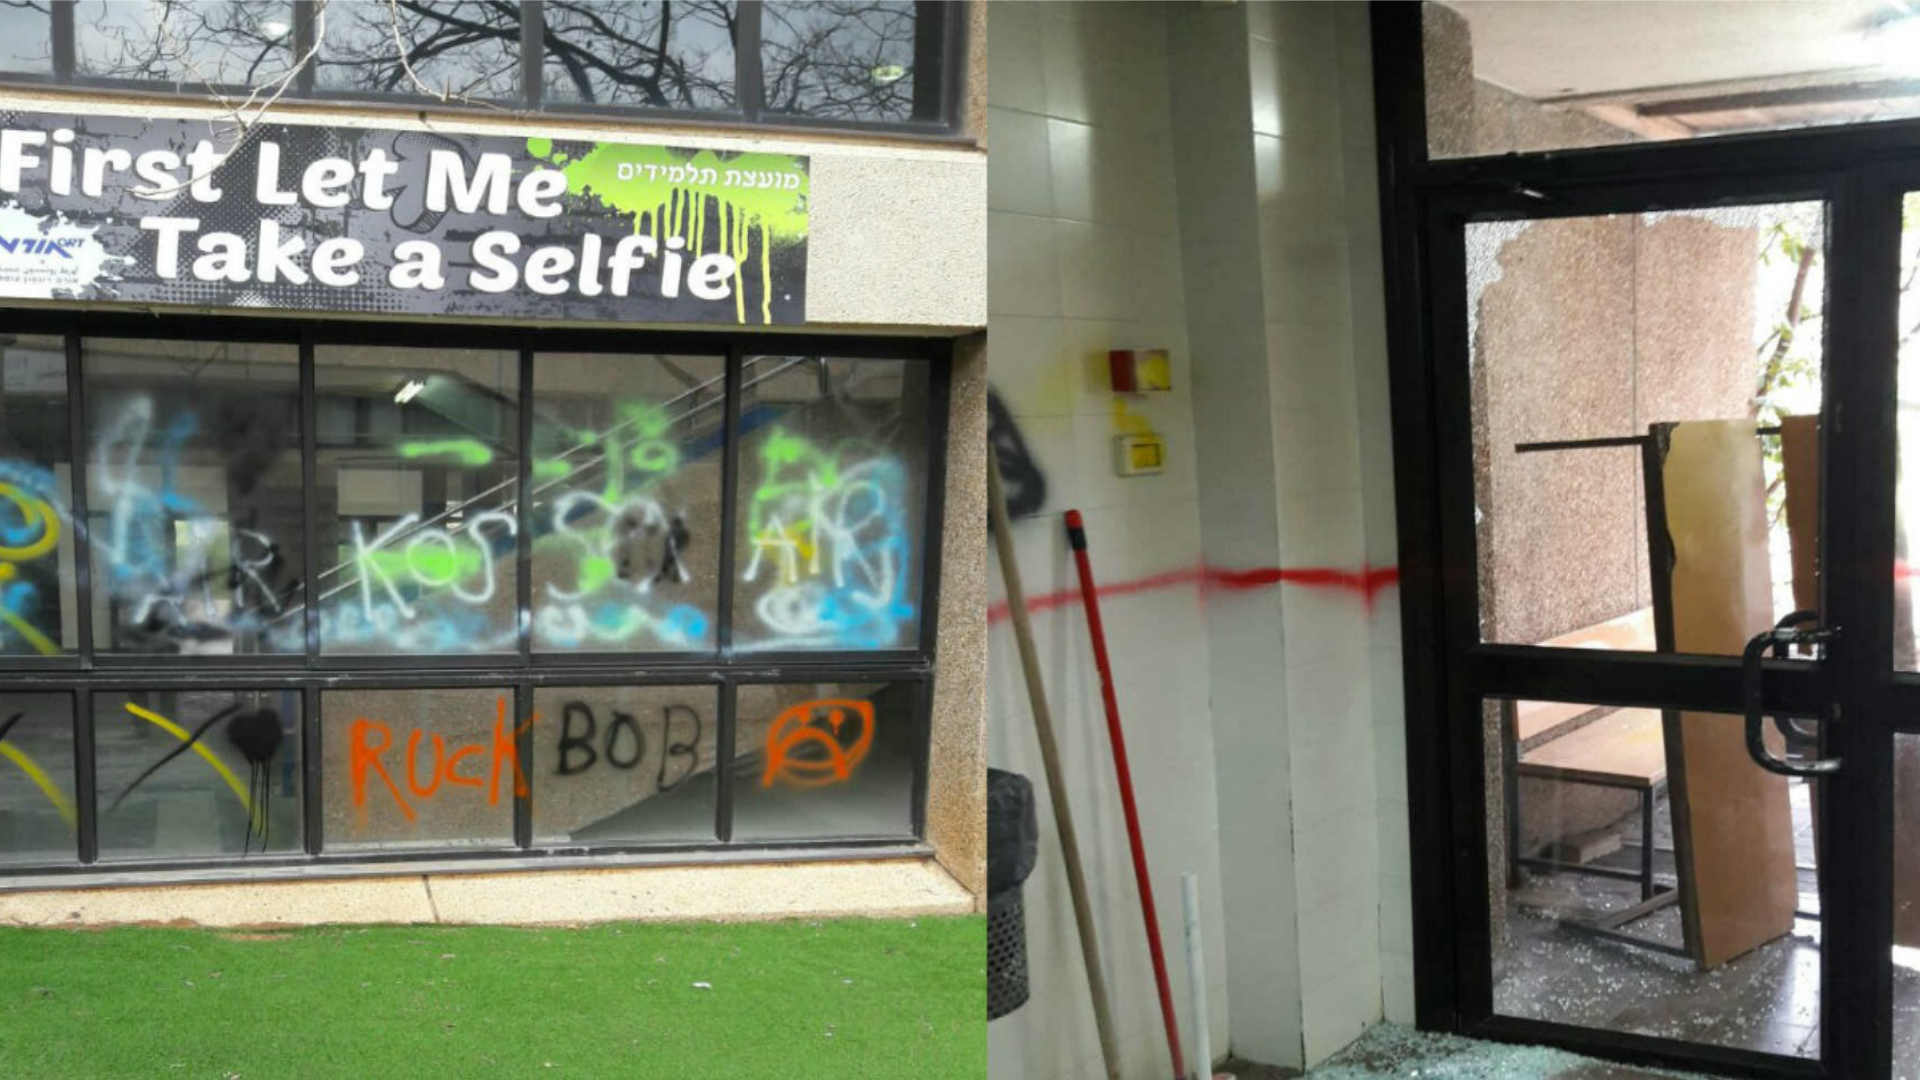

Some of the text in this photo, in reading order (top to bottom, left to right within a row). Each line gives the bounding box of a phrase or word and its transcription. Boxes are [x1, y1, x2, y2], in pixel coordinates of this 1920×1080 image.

[0, 128, 568, 218] First Let Me
[617, 160, 801, 190] מועצת תלמידים
[140, 215, 736, 300] Take a Selfie
[554, 701, 703, 792] BOB
